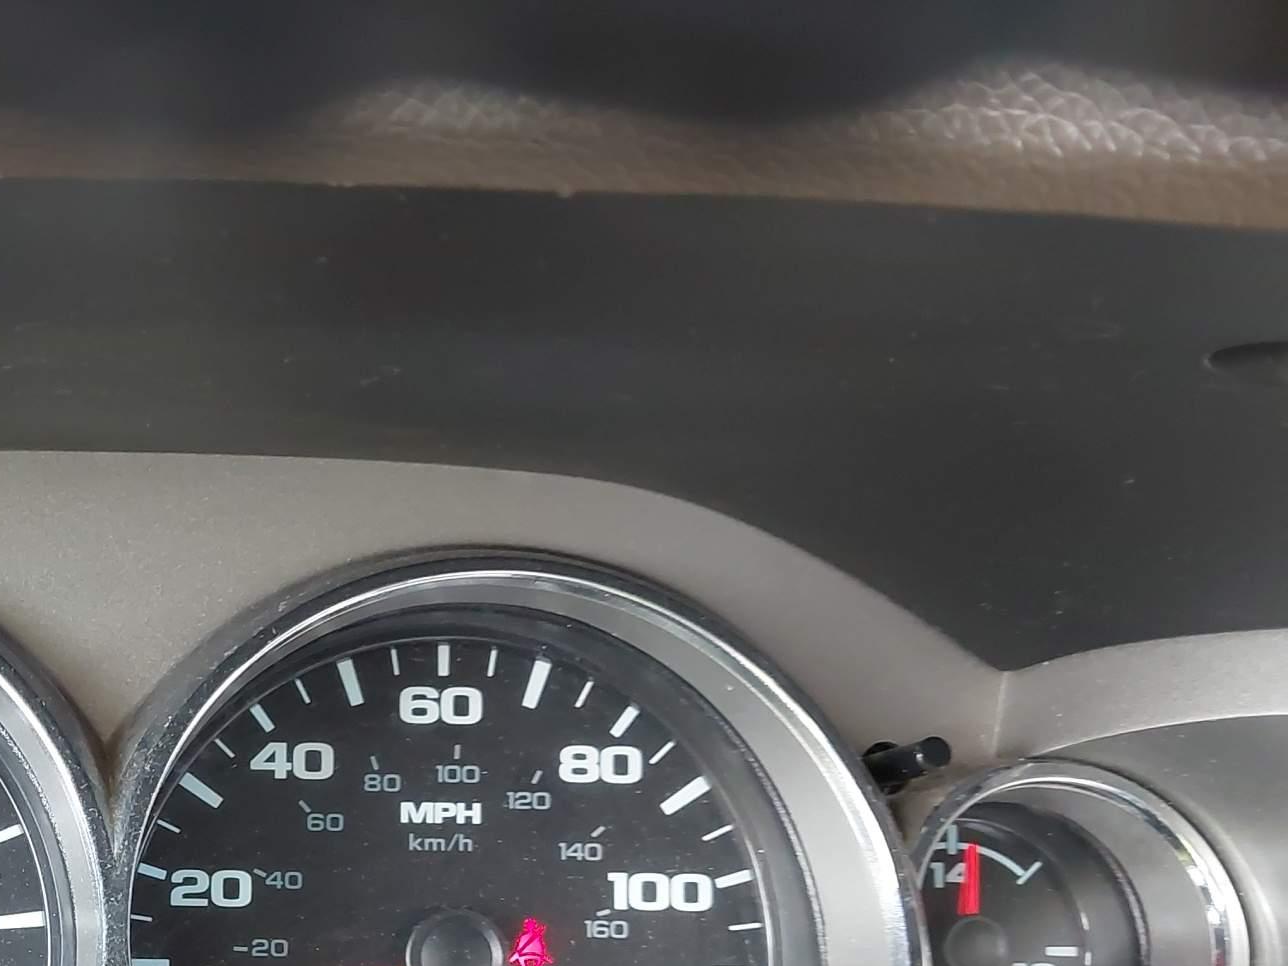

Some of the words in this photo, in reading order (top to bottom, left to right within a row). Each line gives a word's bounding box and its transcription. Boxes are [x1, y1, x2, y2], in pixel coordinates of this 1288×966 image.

[399, 686, 483, 725] 60
[250, 743, 334, 780] 40
[559, 745, 643, 783] 80
[364, 774, 400, 792] 80
[435, 765, 480, 784] 100
[507, 791, 551, 810] 120
[307, 813, 344, 832] 60
[400, 802, 482, 825] MPH
[408, 833, 473, 852] km/h
[559, 843, 602, 861] 140
[170, 869, 253, 907] 20
[264, 872, 303, 890] 40
[607, 873, 712, 912] 100
[585, 920, 628, 940] 160
[251, 939, 288, 958] 20
